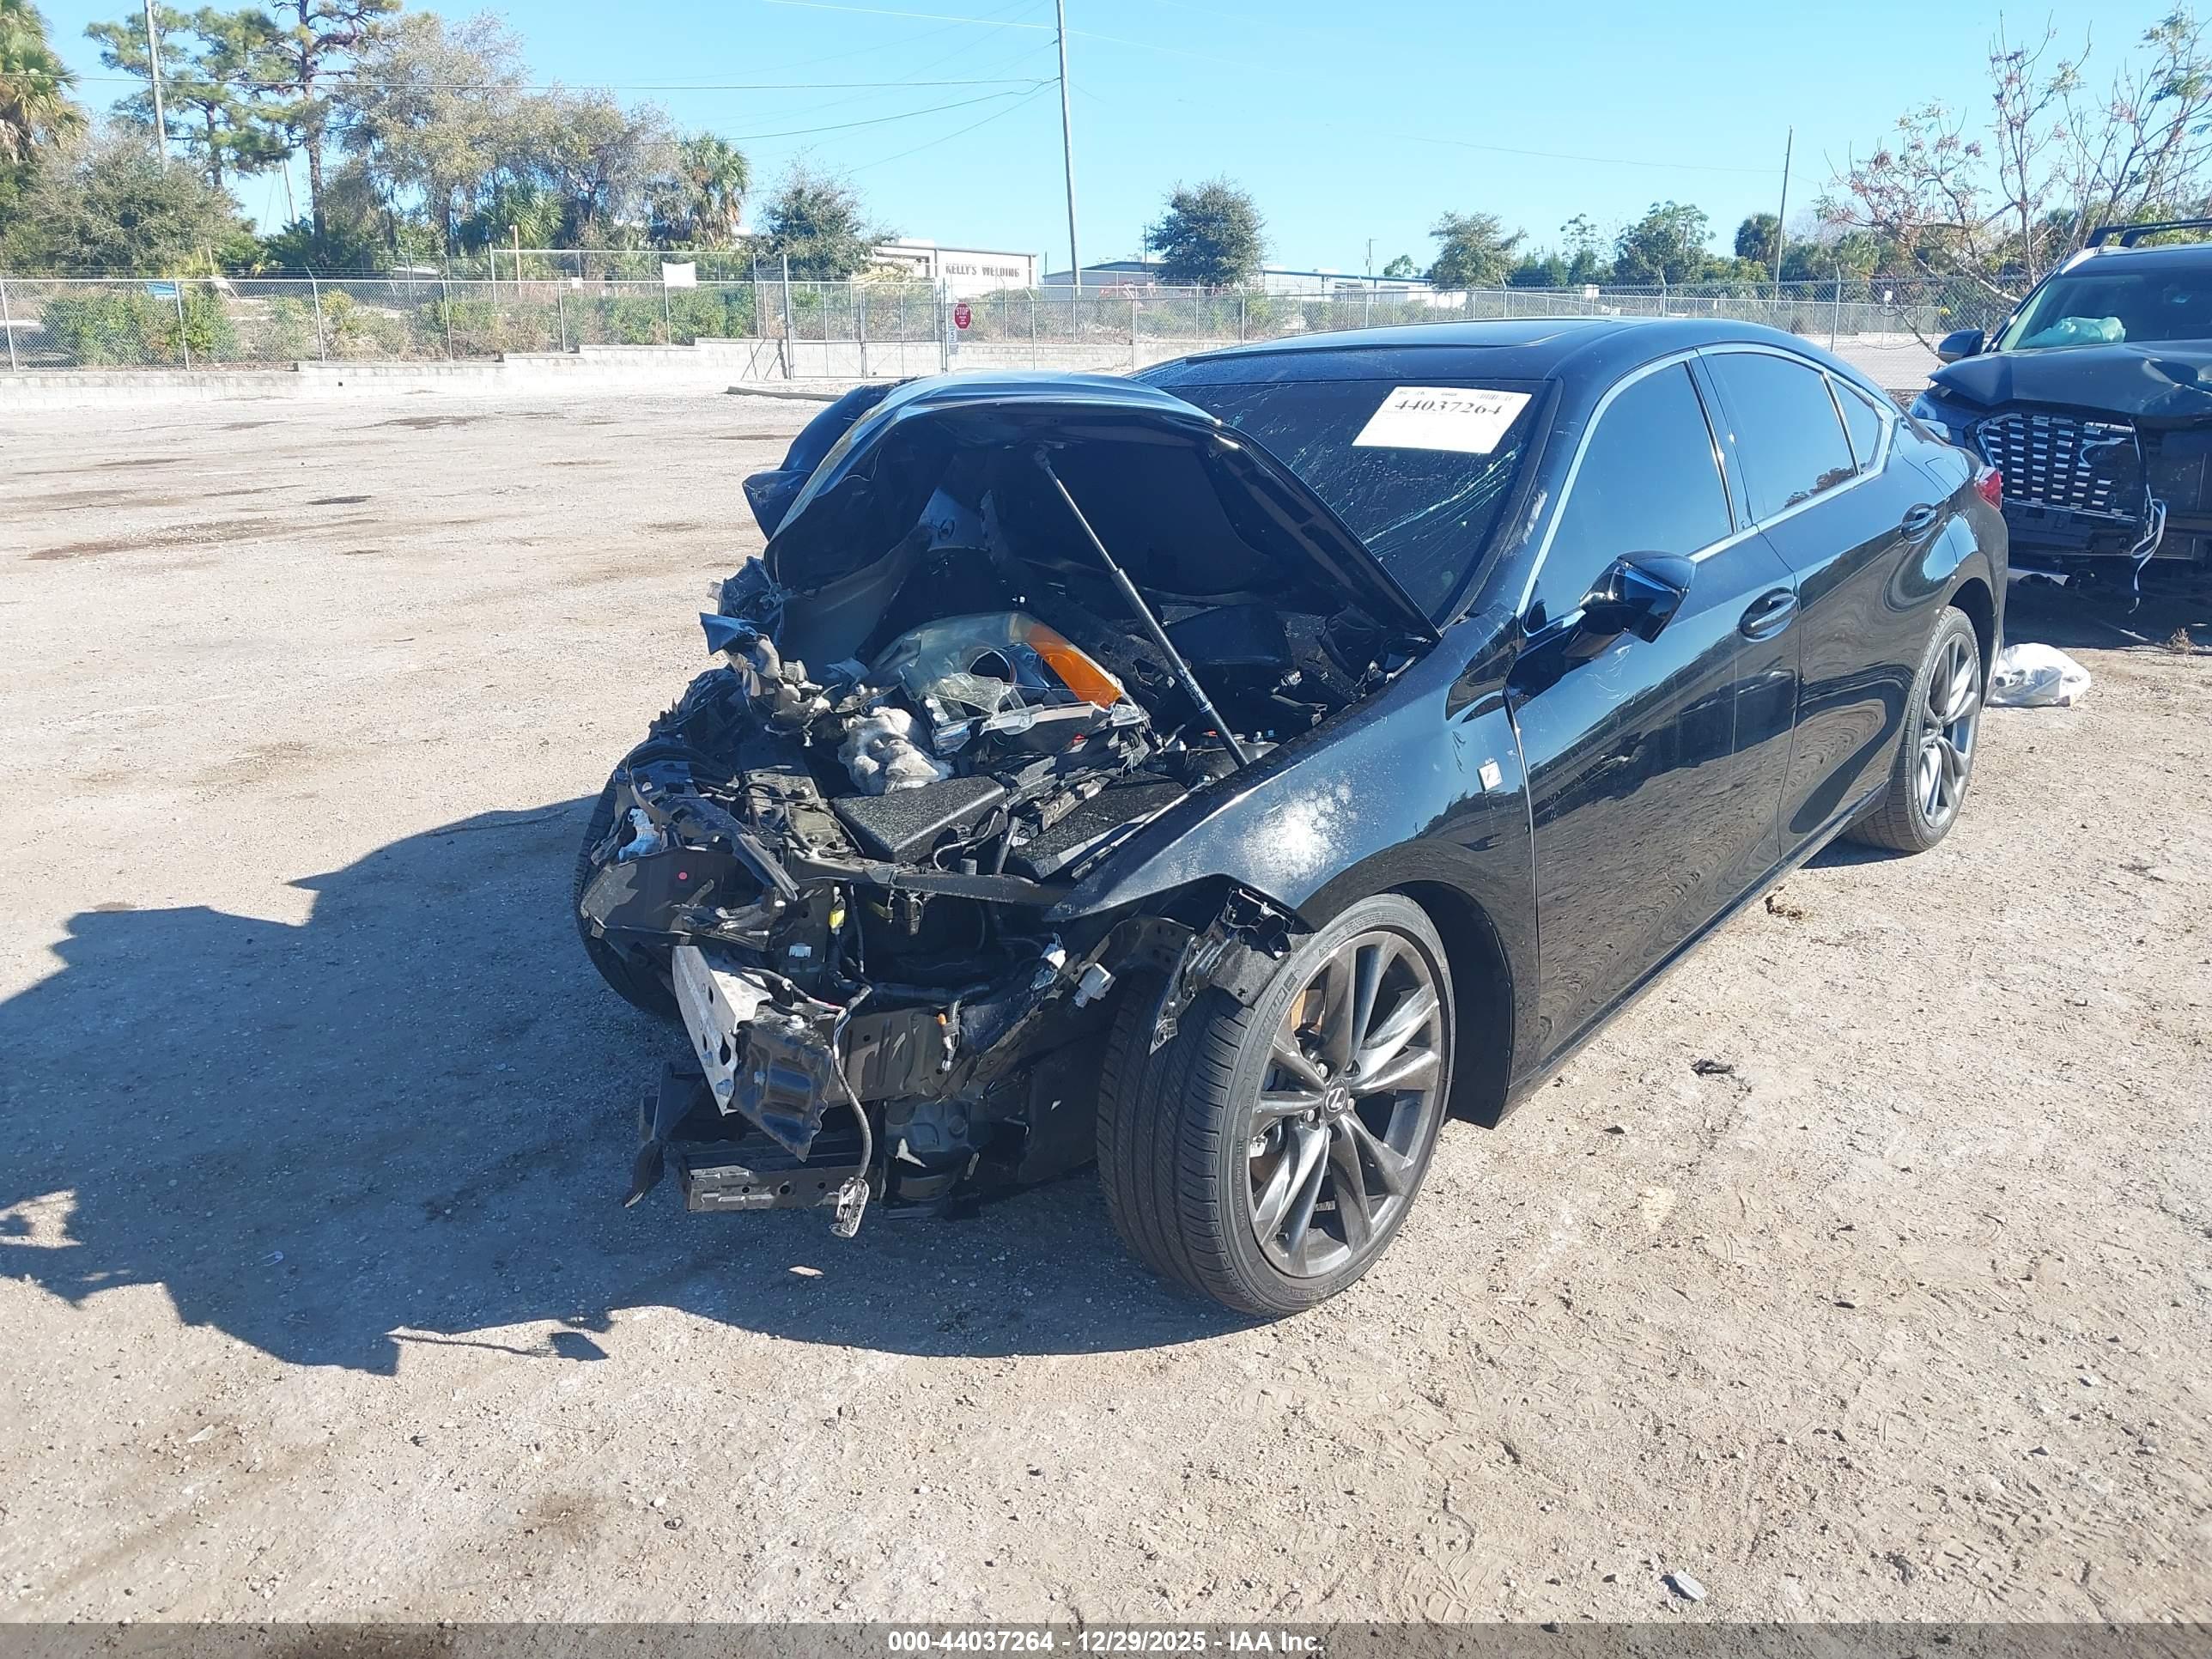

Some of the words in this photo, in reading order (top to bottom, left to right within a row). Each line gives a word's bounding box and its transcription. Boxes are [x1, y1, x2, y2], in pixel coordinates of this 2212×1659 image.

[945, 264, 977, 276] KELLY'S
[981, 266, 1020, 277] WELDING
[956, 307, 969, 316] STOP
[1395, 399, 1503, 416] 44037264
